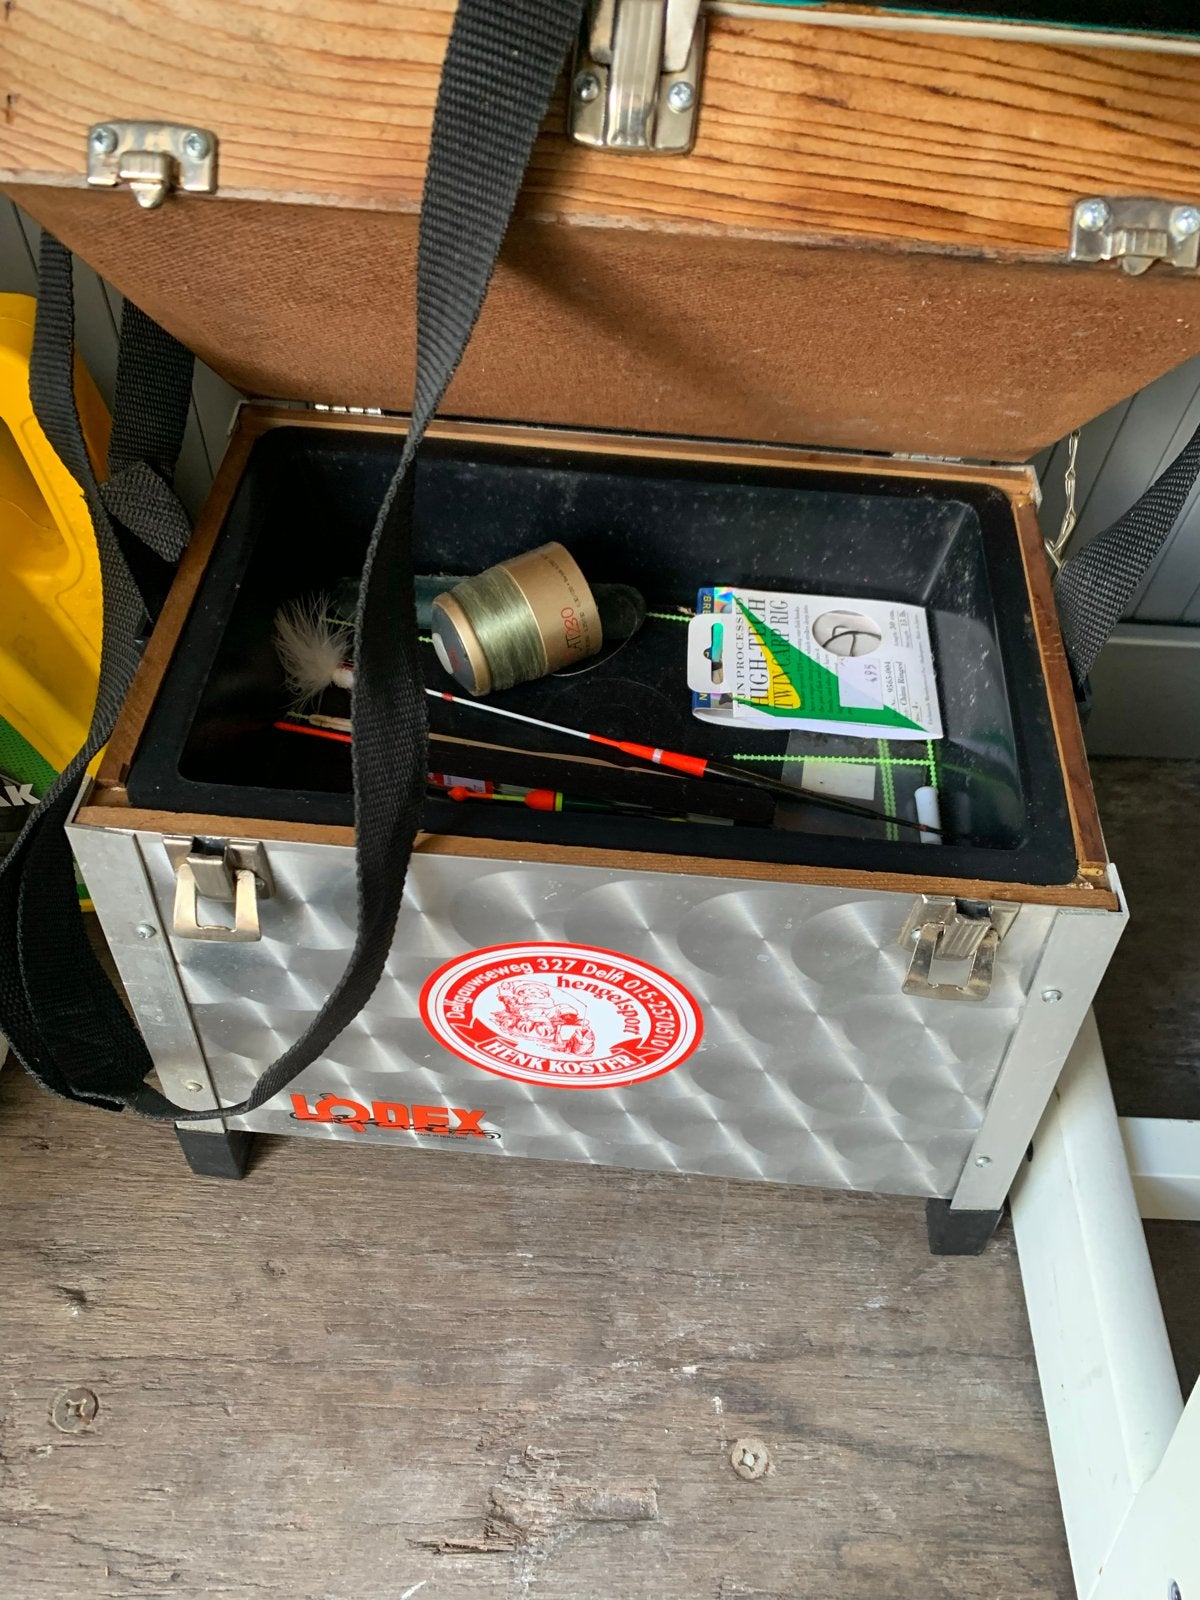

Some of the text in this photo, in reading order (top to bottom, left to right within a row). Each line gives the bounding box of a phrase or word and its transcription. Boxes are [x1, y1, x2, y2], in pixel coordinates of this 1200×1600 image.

[736, 597, 745, 678] PROCESSED
[747, 597, 769, 707] HIGH-TECH
[769, 600, 793, 709] TWIN CARP RIG
[443, 958, 676, 1048] Delfgauwseweg 327 Delft 015-2570510
[556, 975, 642, 1035] hengelsport
[482, 1041, 635, 1075] HENK KOSTER
[290, 1092, 487, 1140] LODEX
